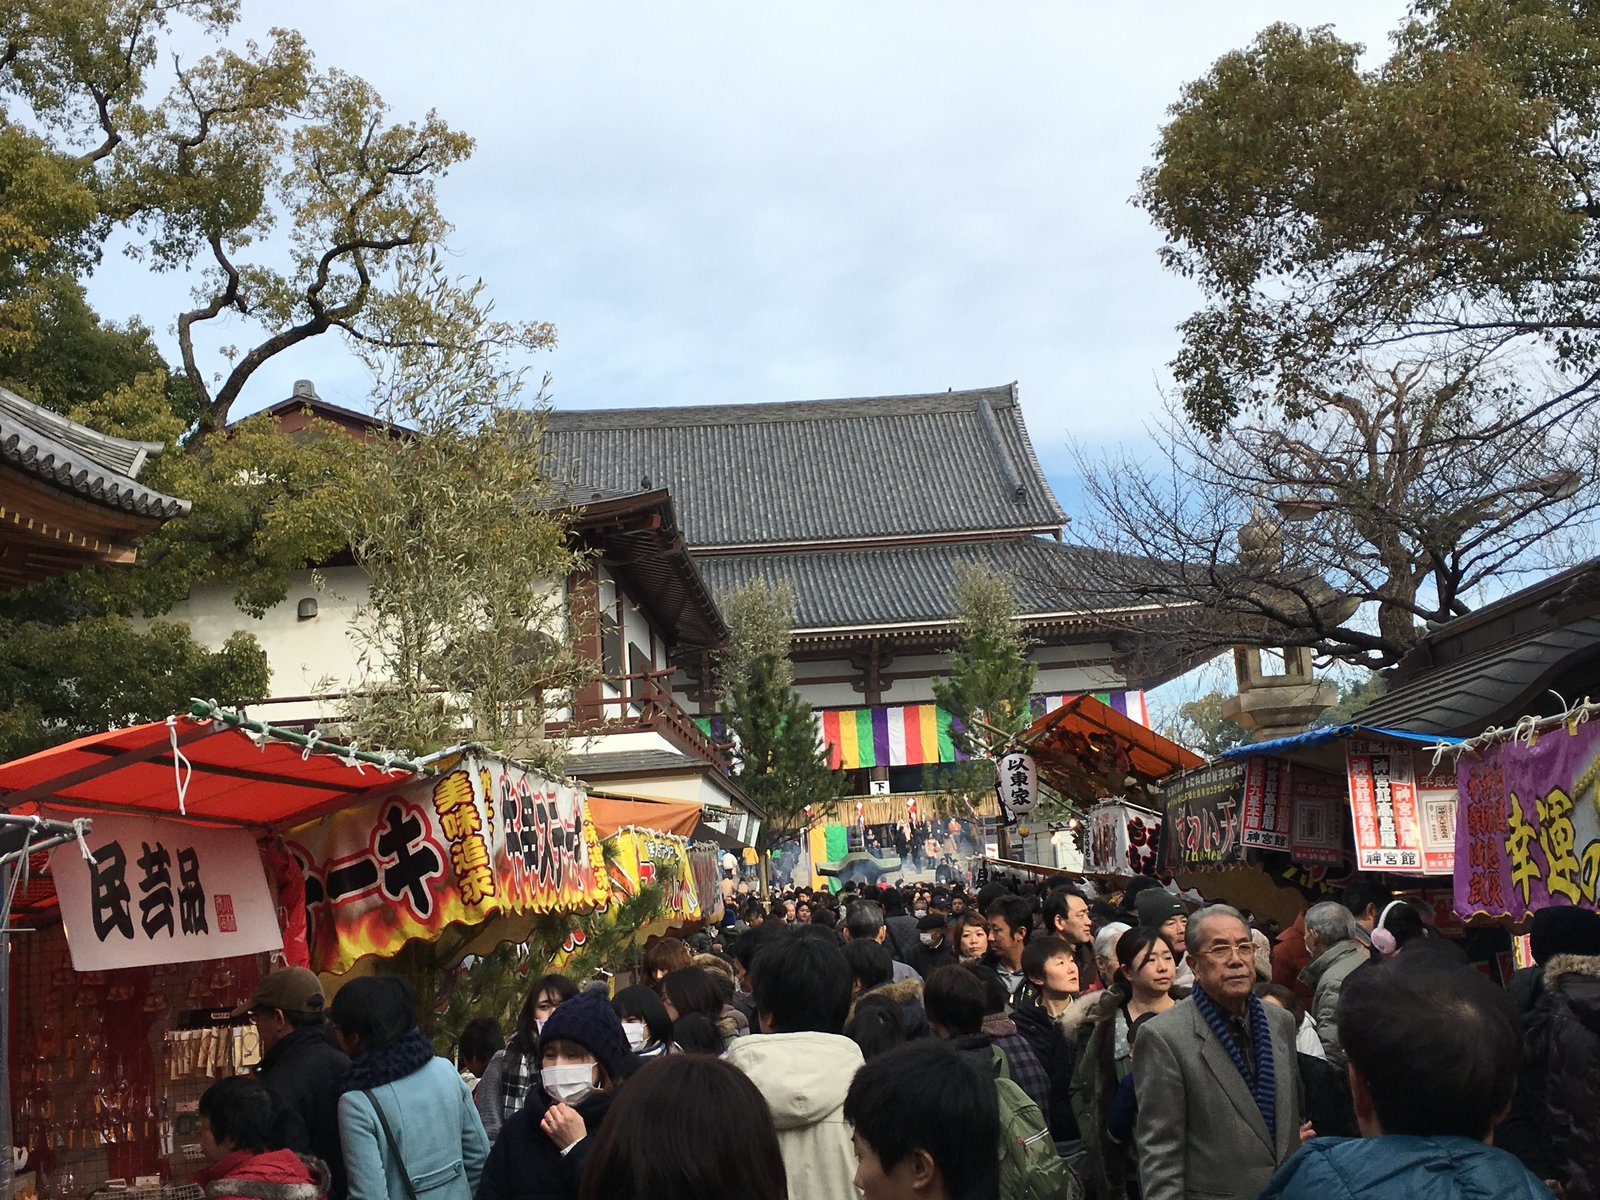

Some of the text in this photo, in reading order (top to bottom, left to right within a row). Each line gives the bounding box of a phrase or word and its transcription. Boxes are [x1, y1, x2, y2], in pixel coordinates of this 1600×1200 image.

[1007, 758, 1030, 805] 以東家
[432, 770, 496, 906] 美味追求
[1246, 831, 1288, 847] 神宮館
[1365, 850, 1416, 866] 神宮館
[88, 839, 209, 942] 民芸品
